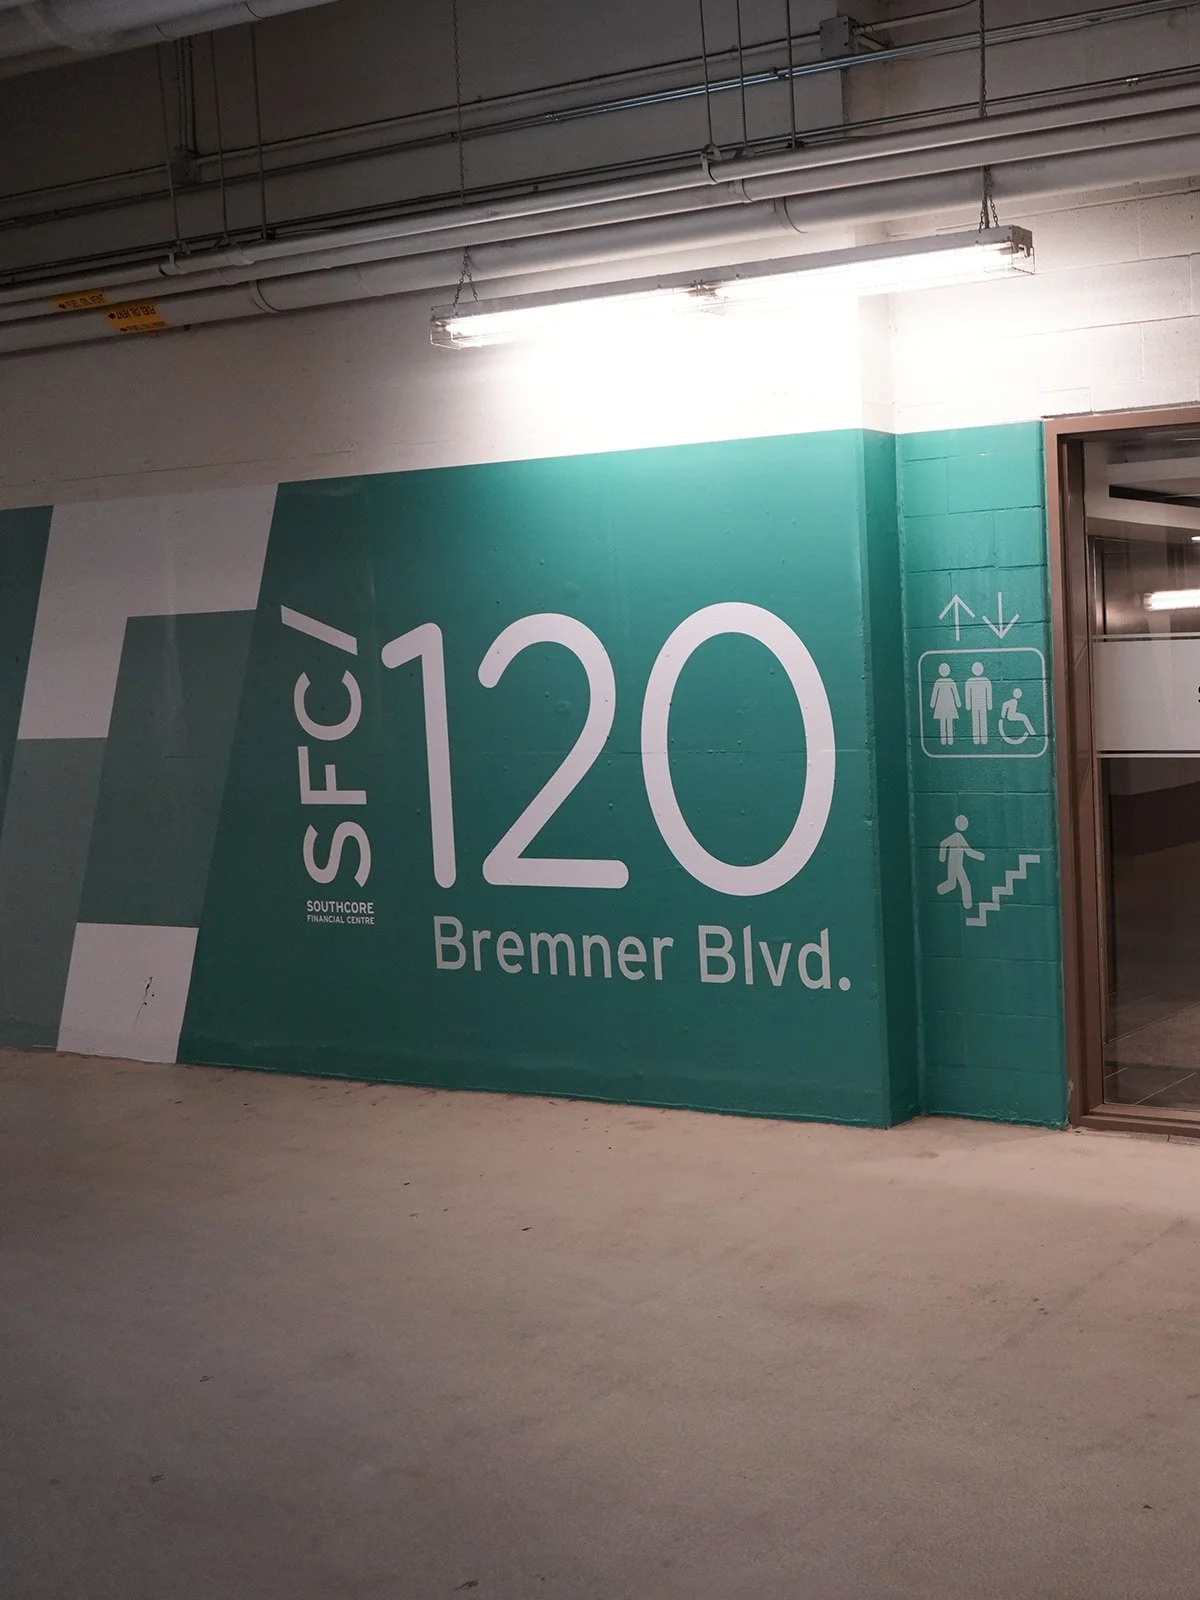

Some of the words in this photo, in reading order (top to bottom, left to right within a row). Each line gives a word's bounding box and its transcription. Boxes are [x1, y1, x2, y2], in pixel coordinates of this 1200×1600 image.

[381, 602, 836, 897] 120
[306, 900, 375, 914] SOUTHCORE
[307, 914, 345, 924] FINANCIAL
[346, 916, 375, 925] CENTRE
[433, 916, 674, 981] Bremner
[698, 925, 853, 991] Blvd.
